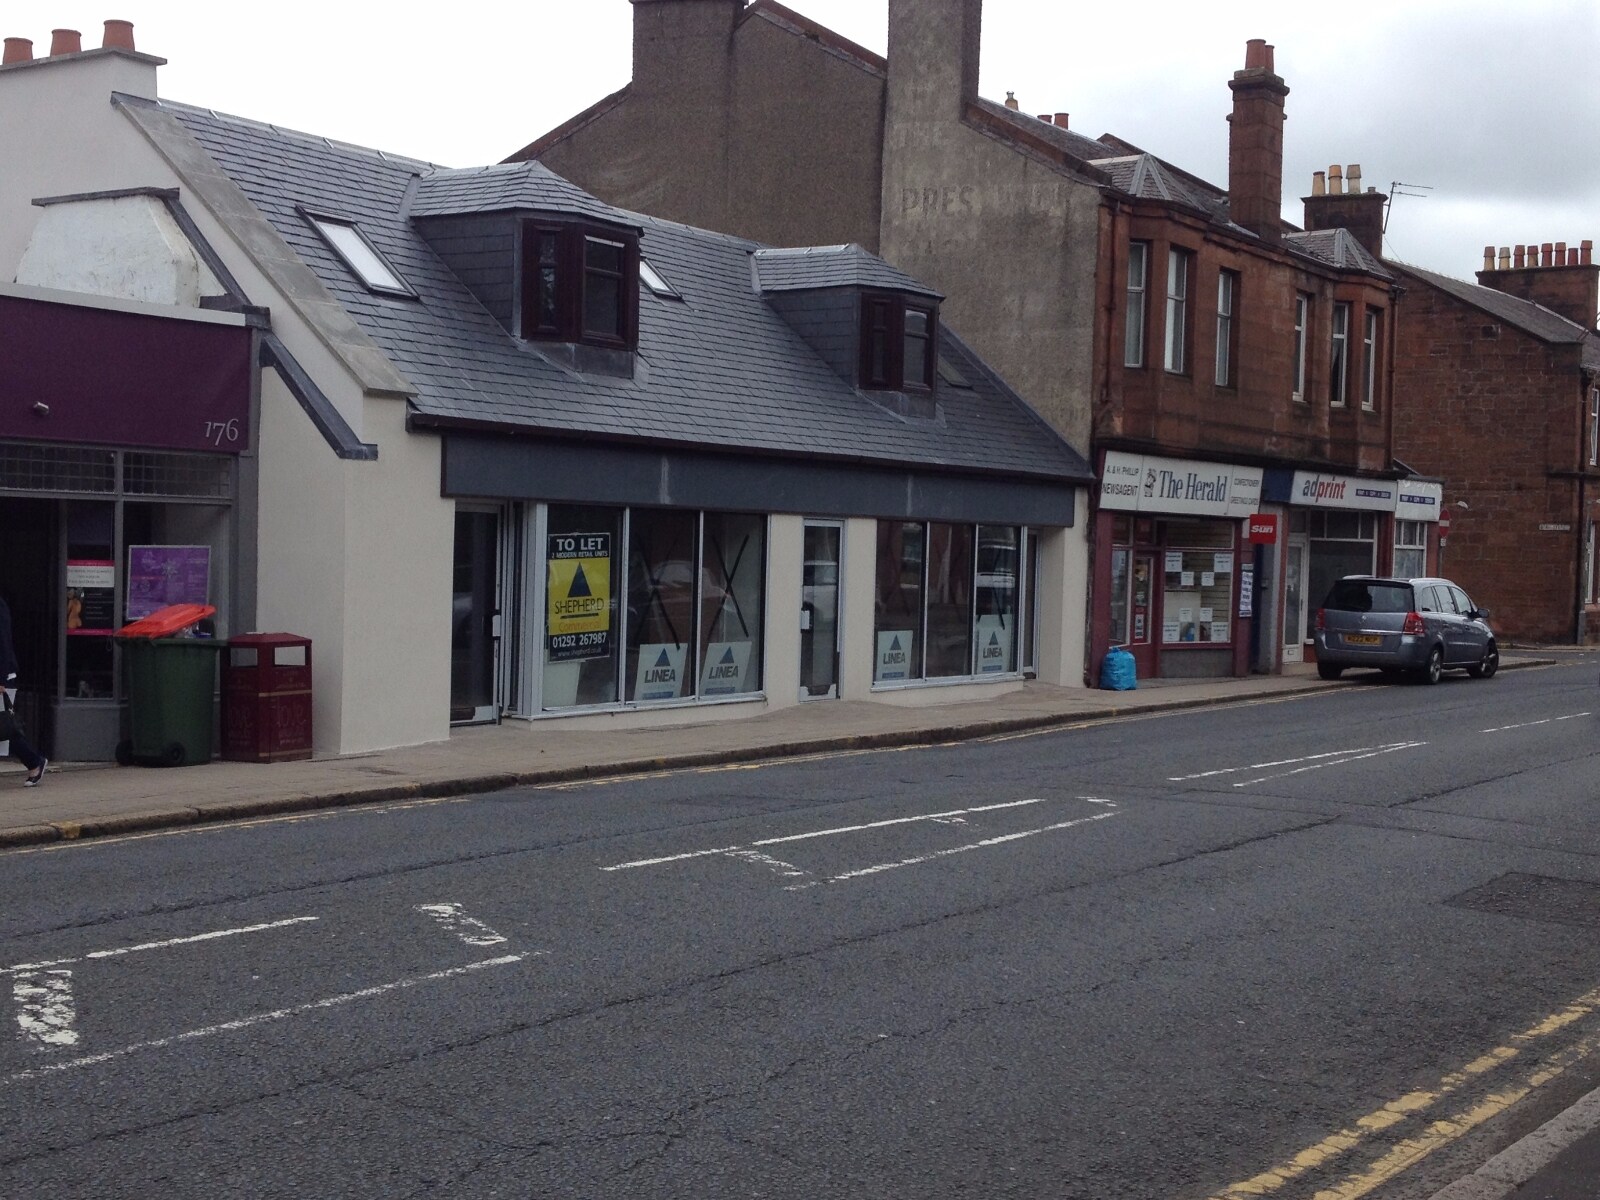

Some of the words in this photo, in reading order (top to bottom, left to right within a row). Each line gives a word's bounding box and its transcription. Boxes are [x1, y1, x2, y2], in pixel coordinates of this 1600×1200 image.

[204, 418, 239, 446] 176
[1102, 482, 1138, 496] NEWSAGENT
[1159, 469, 1184, 500] The
[1185, 473, 1228, 502] Herald
[1302, 474, 1346, 503] adprint
[556, 538, 575, 551] TO
[580, 537, 604, 550] LET
[554, 598, 604, 615] SHEPHERD
[552, 635, 576, 649] 01292
[579, 632, 607, 646] 267987
[883, 652, 906, 665] LINEA
[982, 647, 1003, 659] LINEA
[644, 669, 676, 684] LINEA
[708, 665, 739, 680] LINEA
